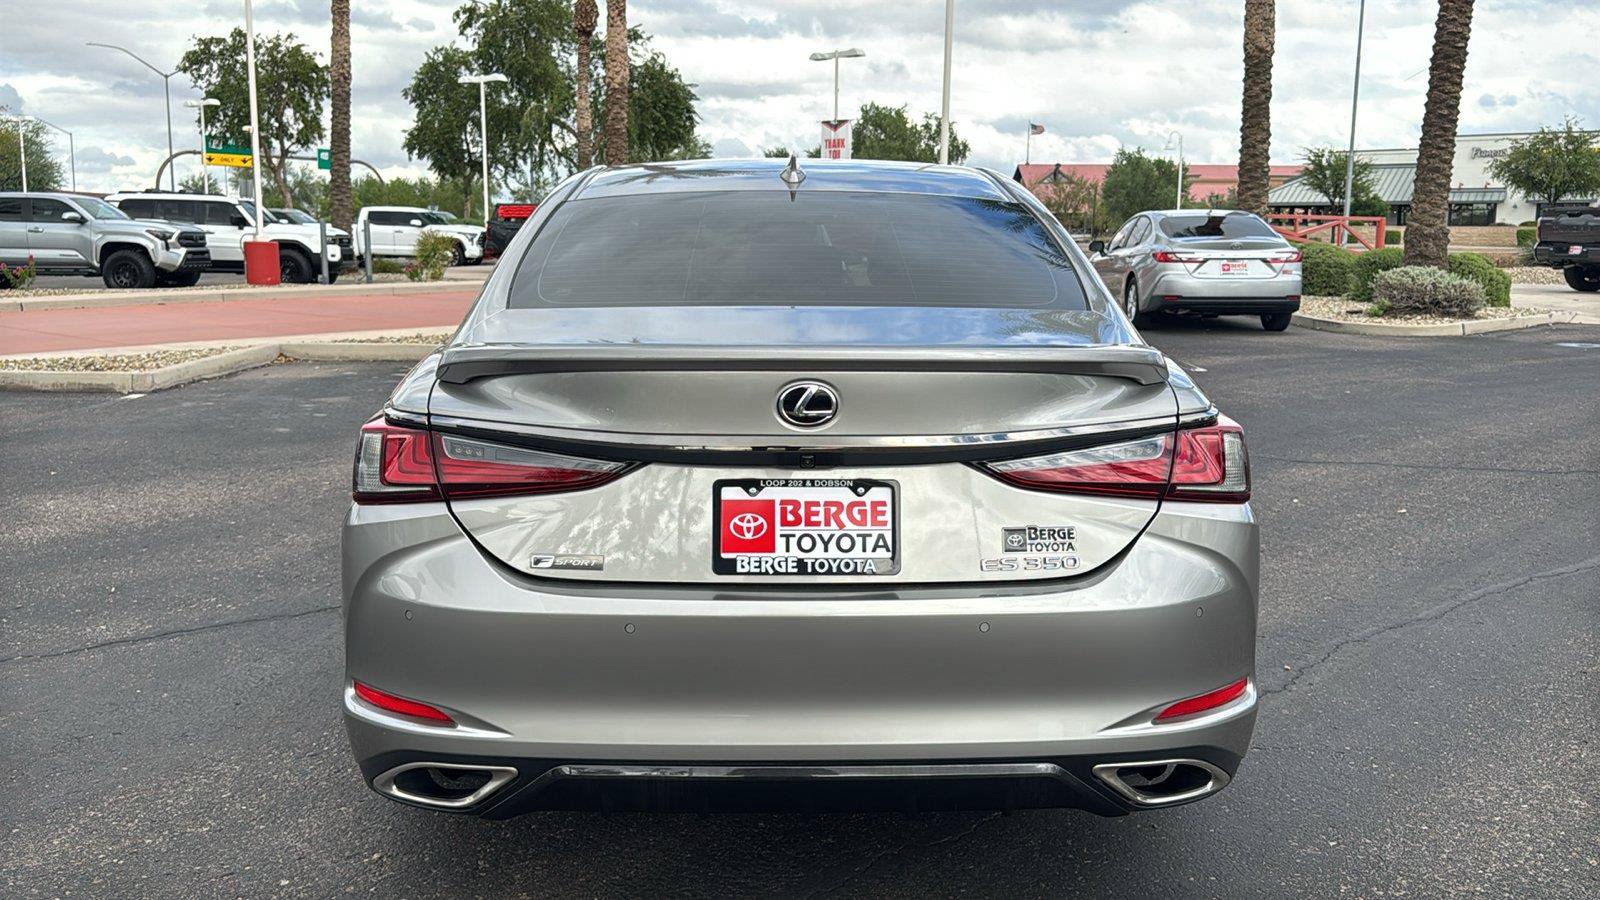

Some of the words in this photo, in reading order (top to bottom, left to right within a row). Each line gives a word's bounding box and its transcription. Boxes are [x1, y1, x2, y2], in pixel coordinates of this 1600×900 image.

[760, 479, 786, 487] LOOP
[788, 479, 803, 487] 202
[805, 479, 812, 487] &
[814, 479, 854, 487] DOBSON
[779, 500, 888, 530] BERGE
[1027, 526, 1076, 541] BERGE
[780, 533, 891, 553] TOYOTA
[1028, 542, 1076, 552] TOYOTA
[553, 559, 600, 567] SPORT
[736, 555, 799, 574] BERGE
[804, 558, 877, 573] TOYOTA
[980, 557, 1019, 572] ES
[1023, 556, 1081, 571] 350
